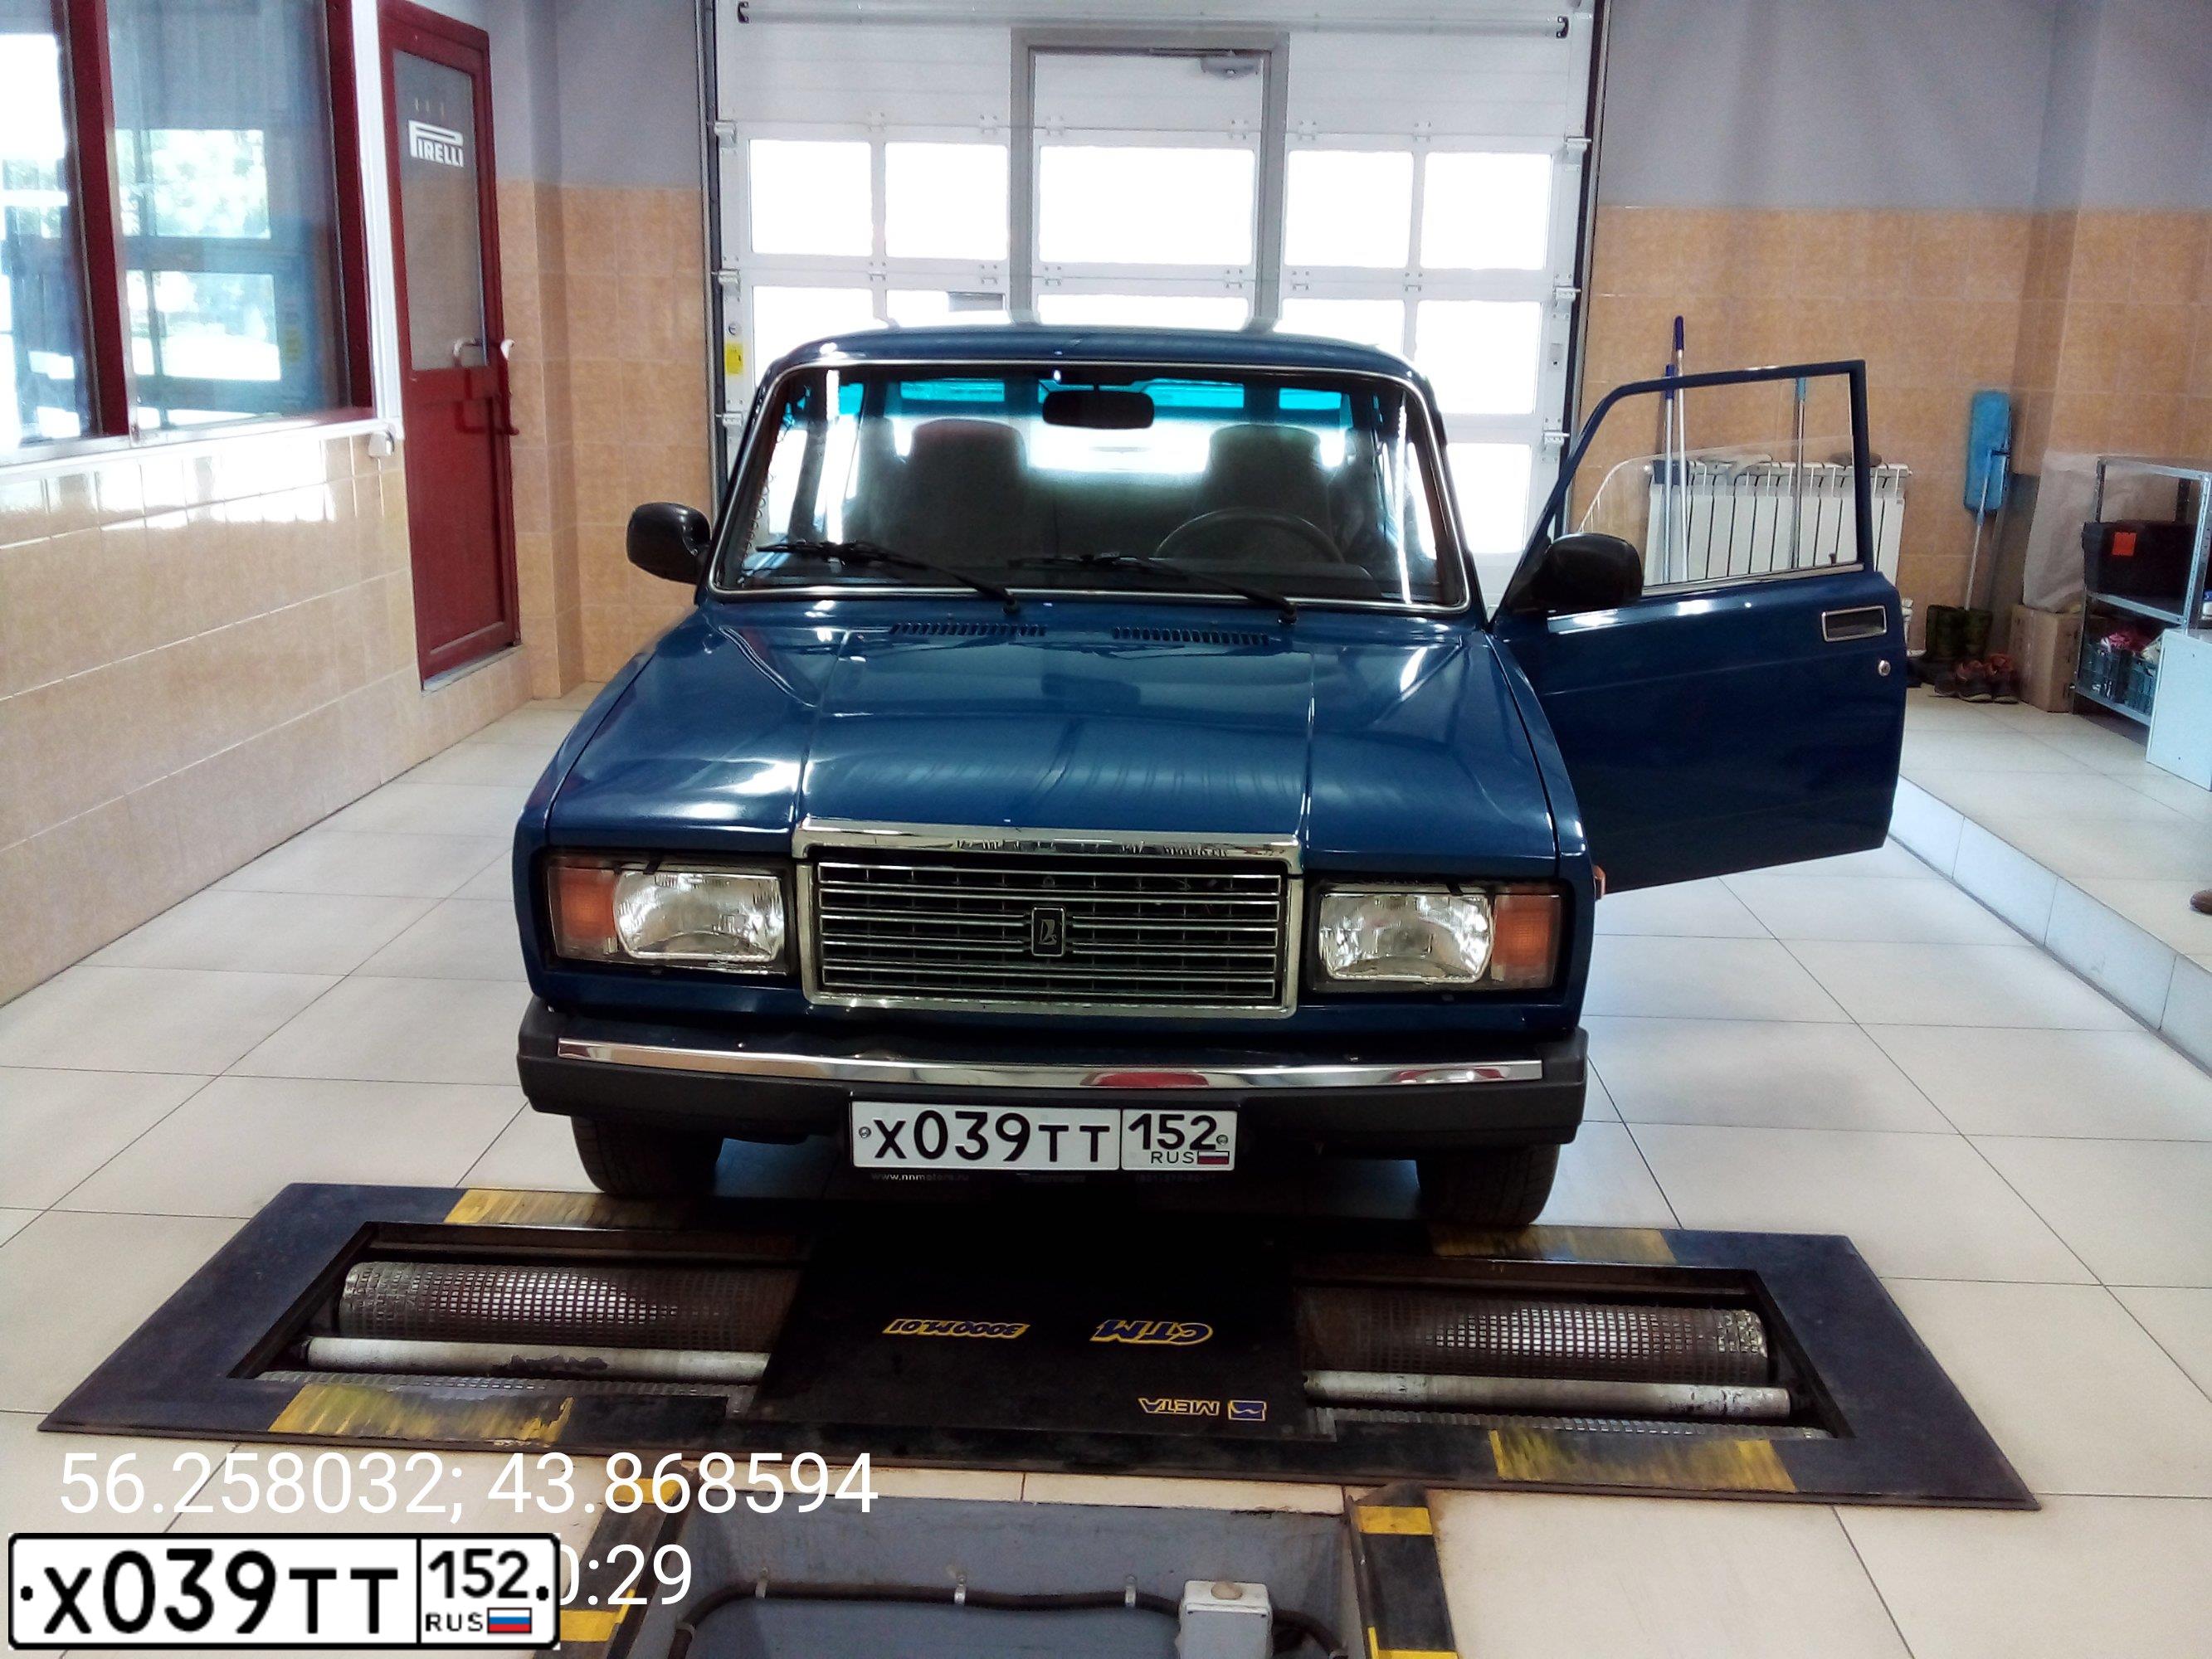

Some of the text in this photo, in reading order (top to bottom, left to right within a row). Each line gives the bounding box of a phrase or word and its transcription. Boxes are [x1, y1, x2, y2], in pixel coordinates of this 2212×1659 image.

[408, 120, 464, 168] PIRELLI
[1128, 1113, 1217, 1151] 152
[1151, 1151, 1194, 1164] RUS
